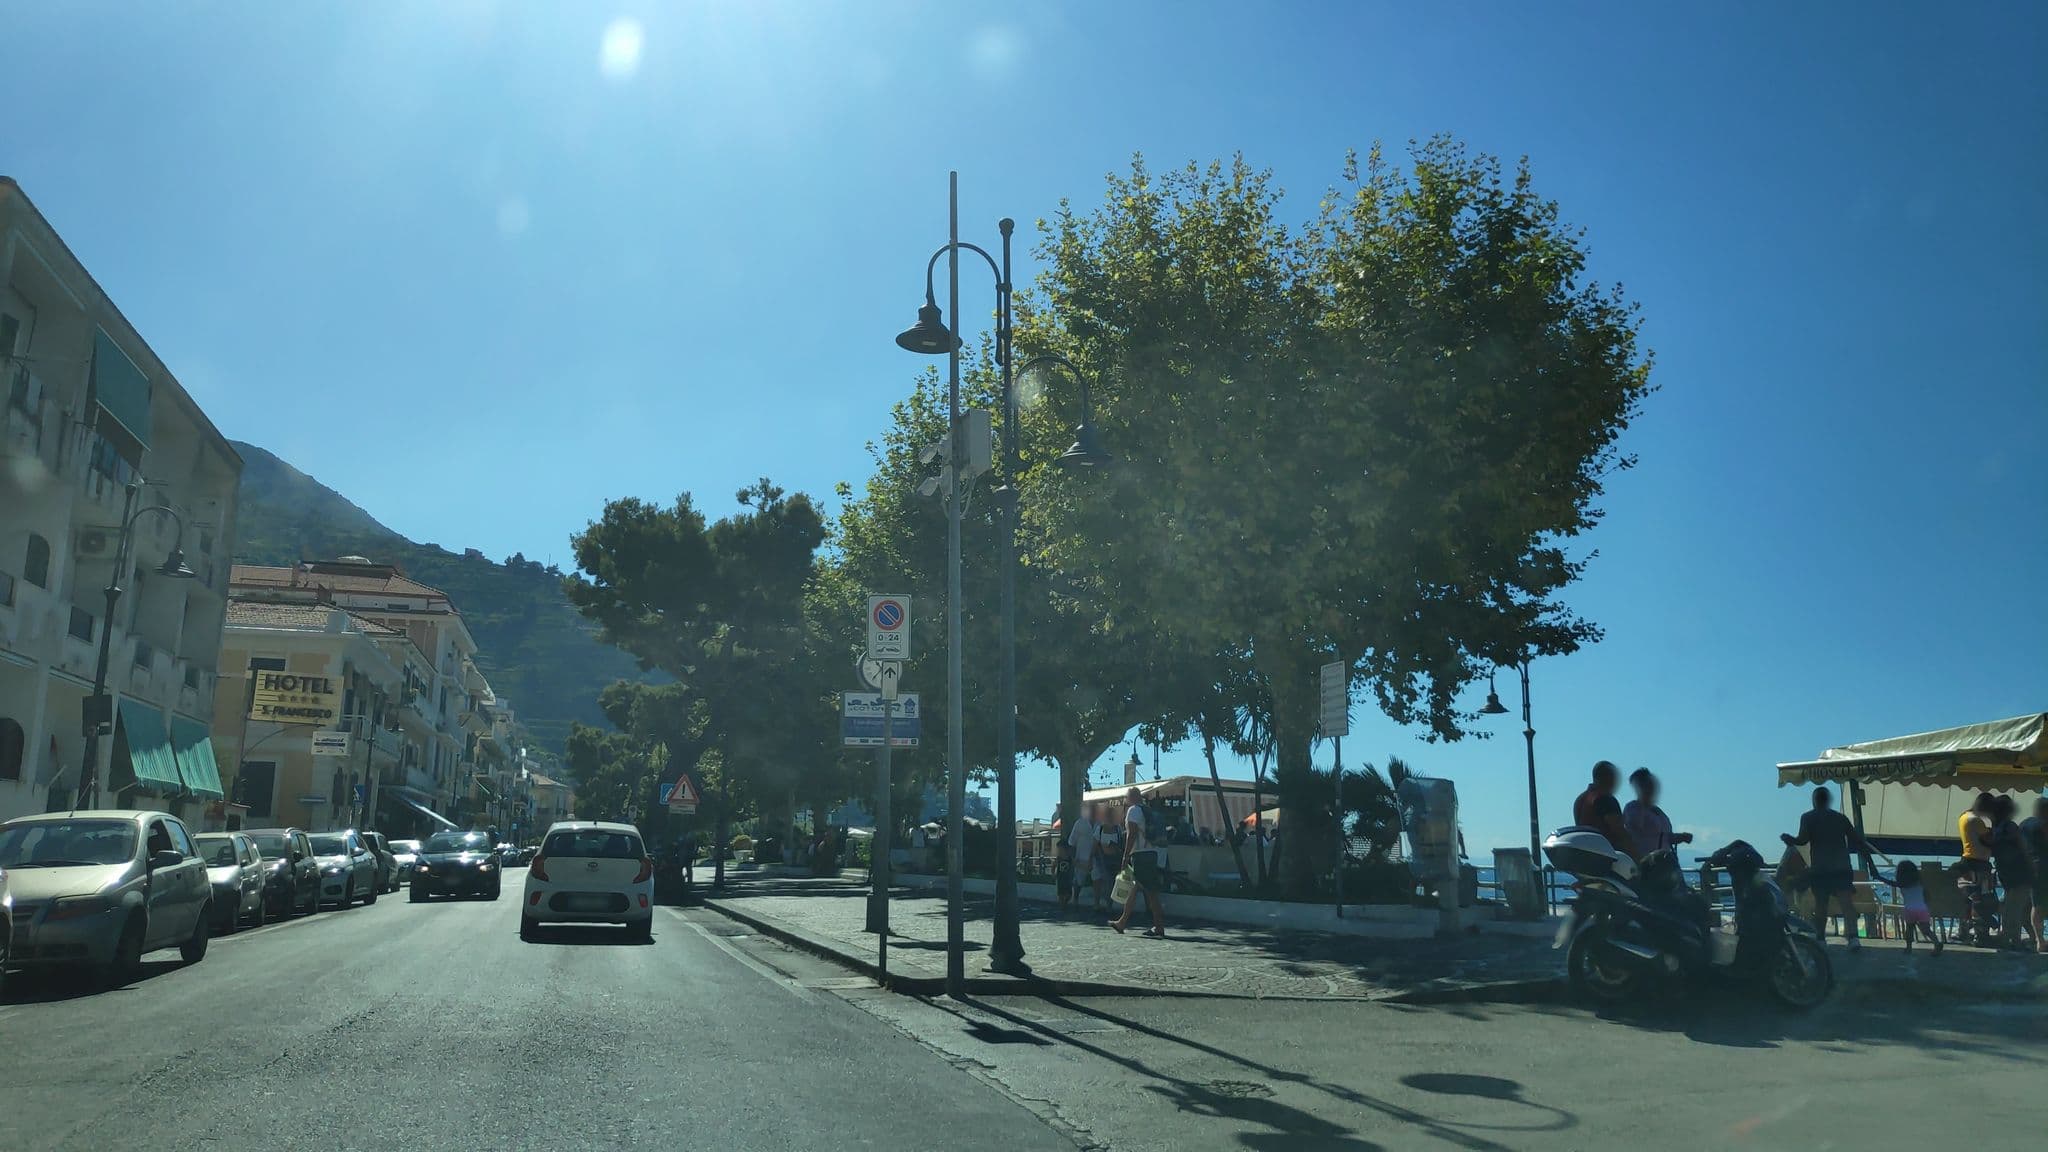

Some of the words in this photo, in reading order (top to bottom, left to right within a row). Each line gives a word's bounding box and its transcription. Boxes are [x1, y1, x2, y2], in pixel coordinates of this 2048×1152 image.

[264, 674, 333, 694] HOTEL
[1801, 766, 1850, 777] CHIOSCO
[1857, 764, 1879, 776] BAR
[1886, 759, 1926, 773] LAURA
